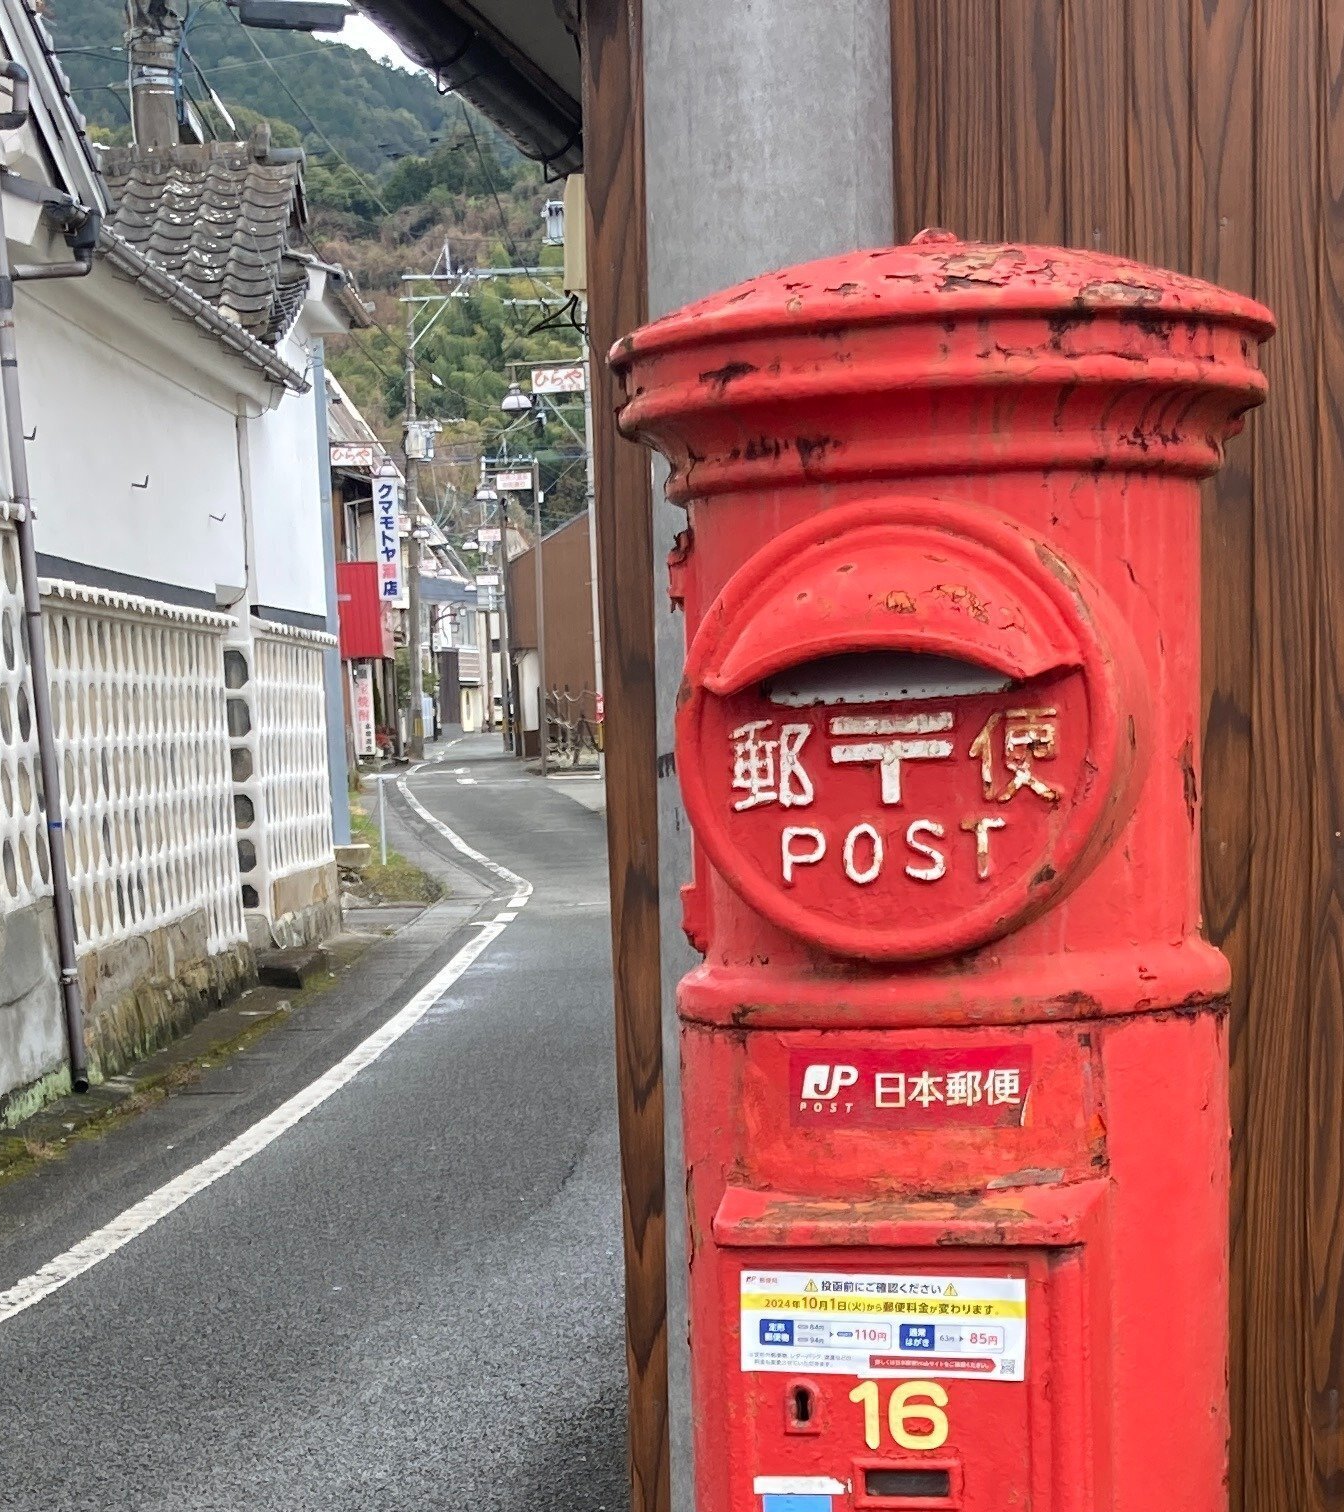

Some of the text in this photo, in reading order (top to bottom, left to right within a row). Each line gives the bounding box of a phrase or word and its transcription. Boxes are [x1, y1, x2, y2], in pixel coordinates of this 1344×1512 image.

[535, 369, 581, 387] ひらや
[332, 449, 370, 462] ひらや
[377, 484, 398, 596] クマモトヤ酒店
[781, 817, 1006, 884] POST
[874, 1068, 1021, 1108] 日本郵便
[799, 1102, 853, 1114] POST
[821, 1280, 942, 1295] 投函前にご確認ください
[855, 1329, 887, 1342] 110円
[905, 1337, 930, 1348] はがき
[969, 1332, 998, 1346] 85円
[848, 1380, 949, 1450] 16
